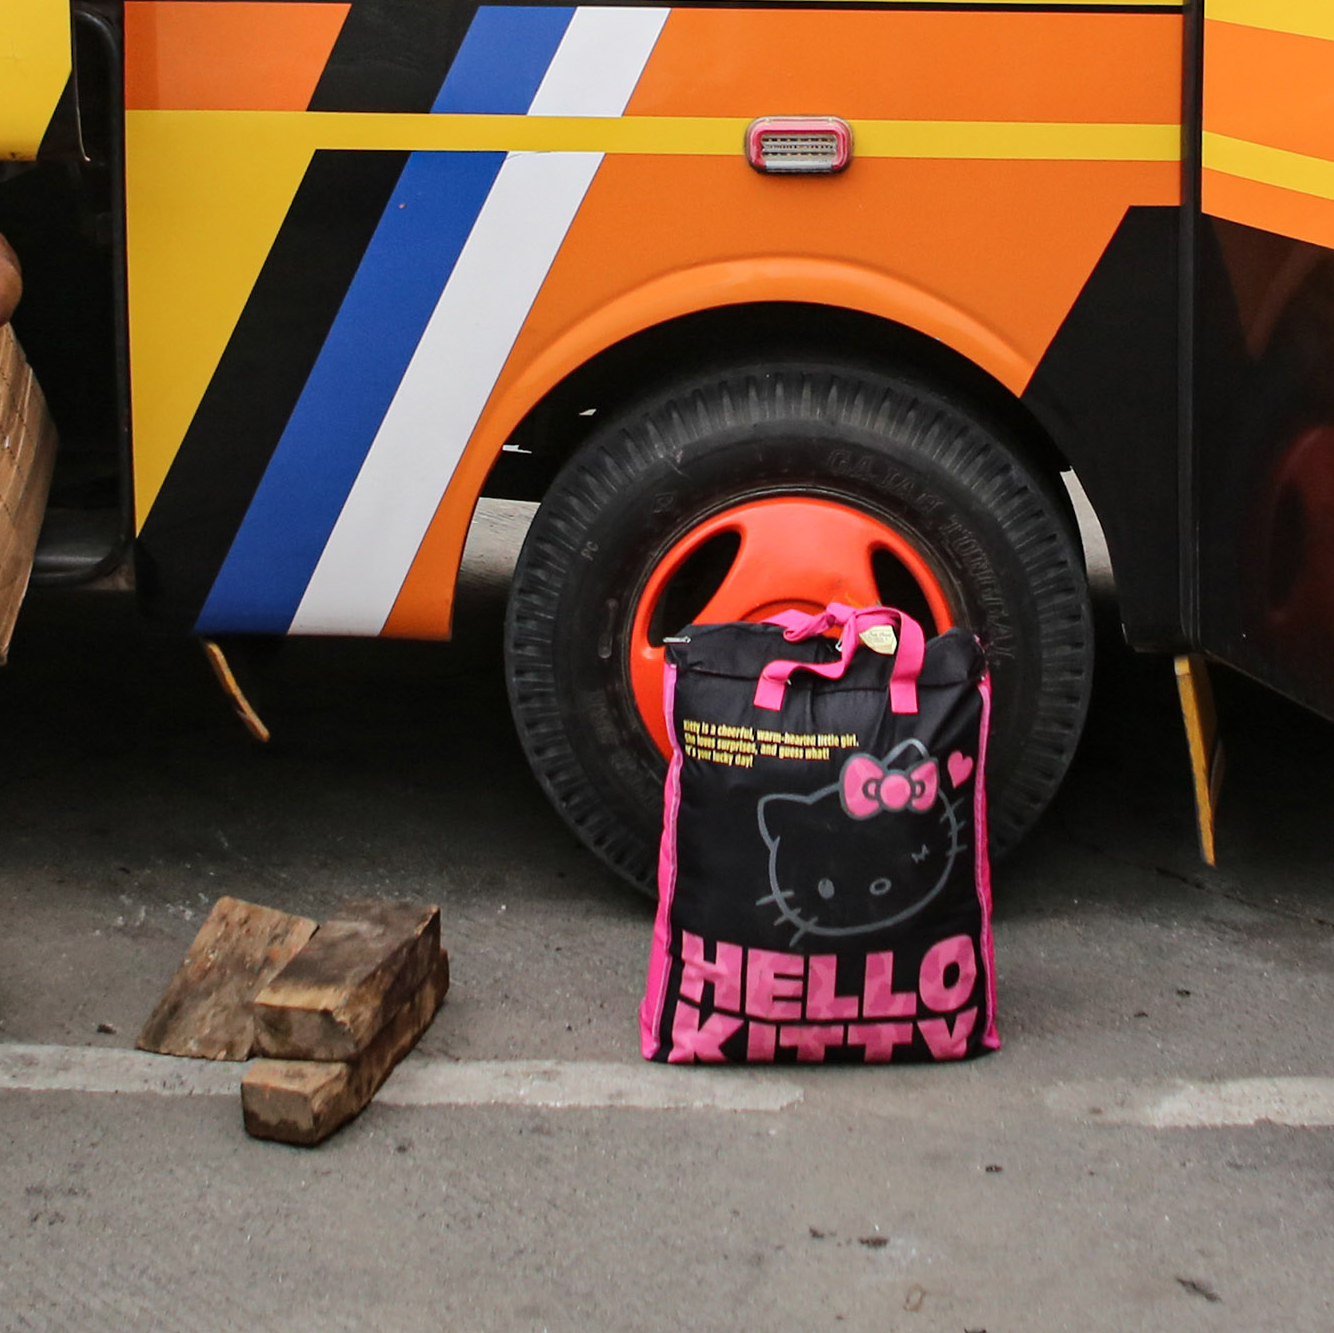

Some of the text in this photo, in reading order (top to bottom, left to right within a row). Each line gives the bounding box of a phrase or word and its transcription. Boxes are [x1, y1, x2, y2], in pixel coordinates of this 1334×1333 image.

[696, 734, 715, 748] loves
[760, 743, 777, 756] and
[779, 745, 804, 759] guess
[701, 721, 709, 734] is
[817, 733, 839, 747] little
[712, 749, 733, 766] lucky
[681, 929, 977, 1020] HELLO
[668, 1000, 977, 1063] KITTY
